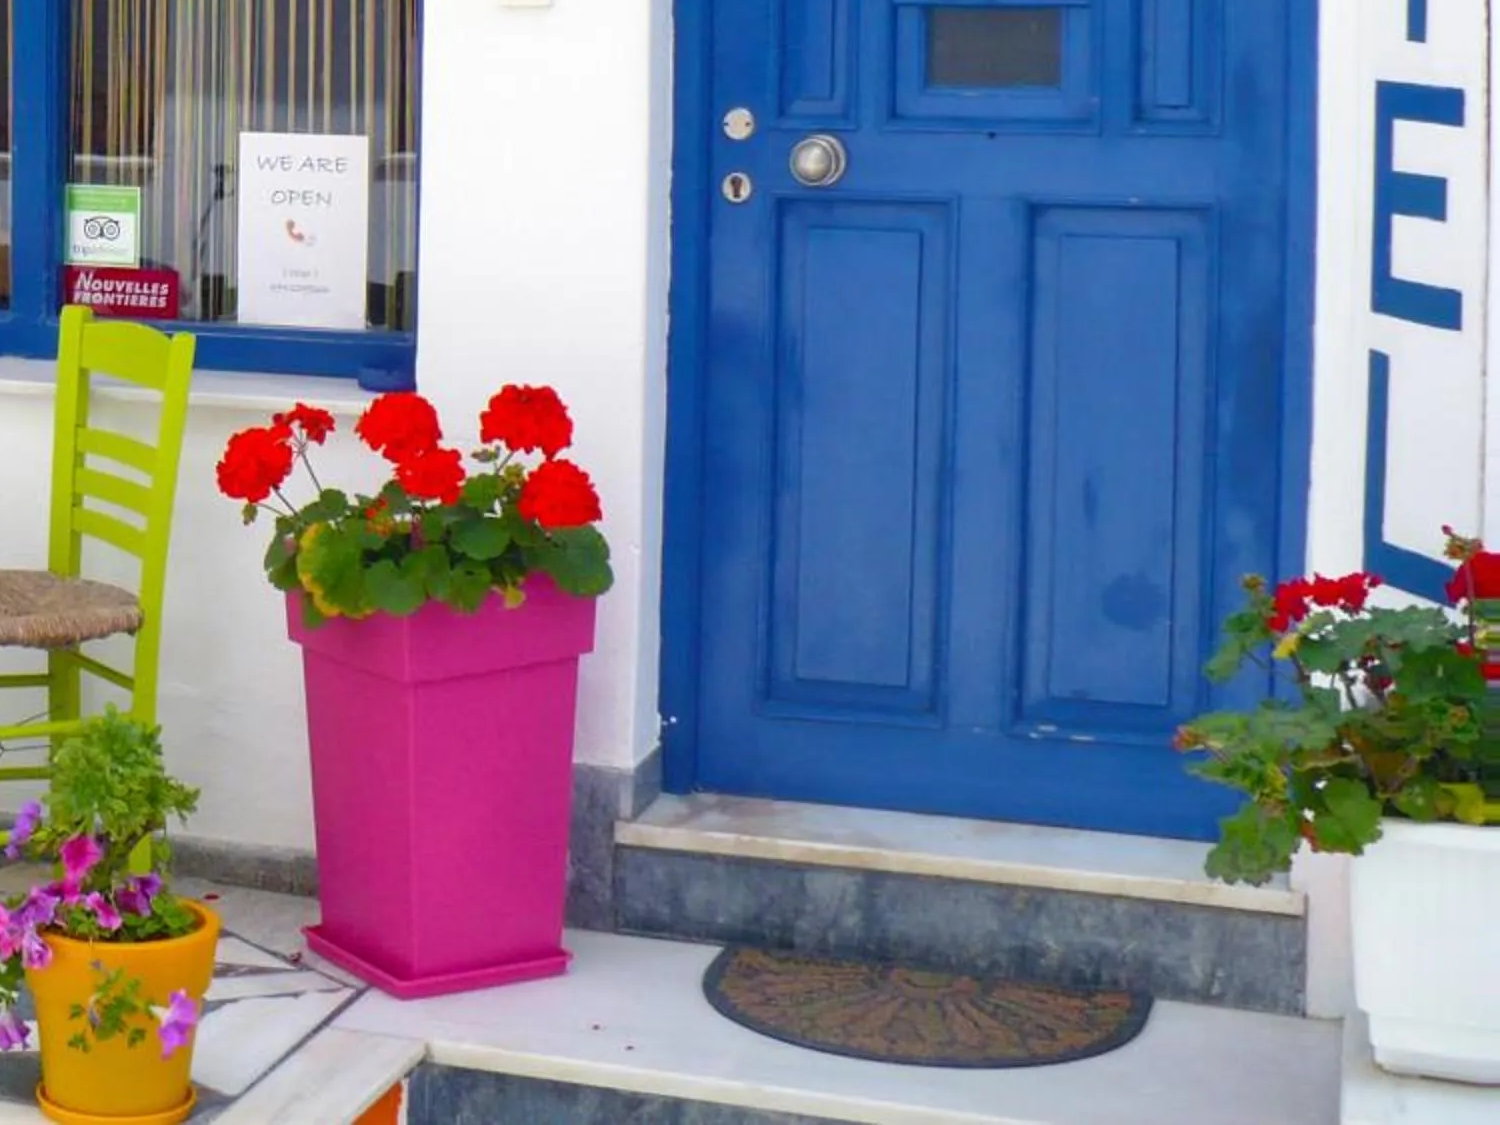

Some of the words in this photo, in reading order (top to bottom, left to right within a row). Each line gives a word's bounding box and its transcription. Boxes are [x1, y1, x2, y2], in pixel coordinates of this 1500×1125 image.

[257, 154, 295, 172] WE
[298, 155, 350, 174] ARE
[271, 189, 332, 207] OPEN
